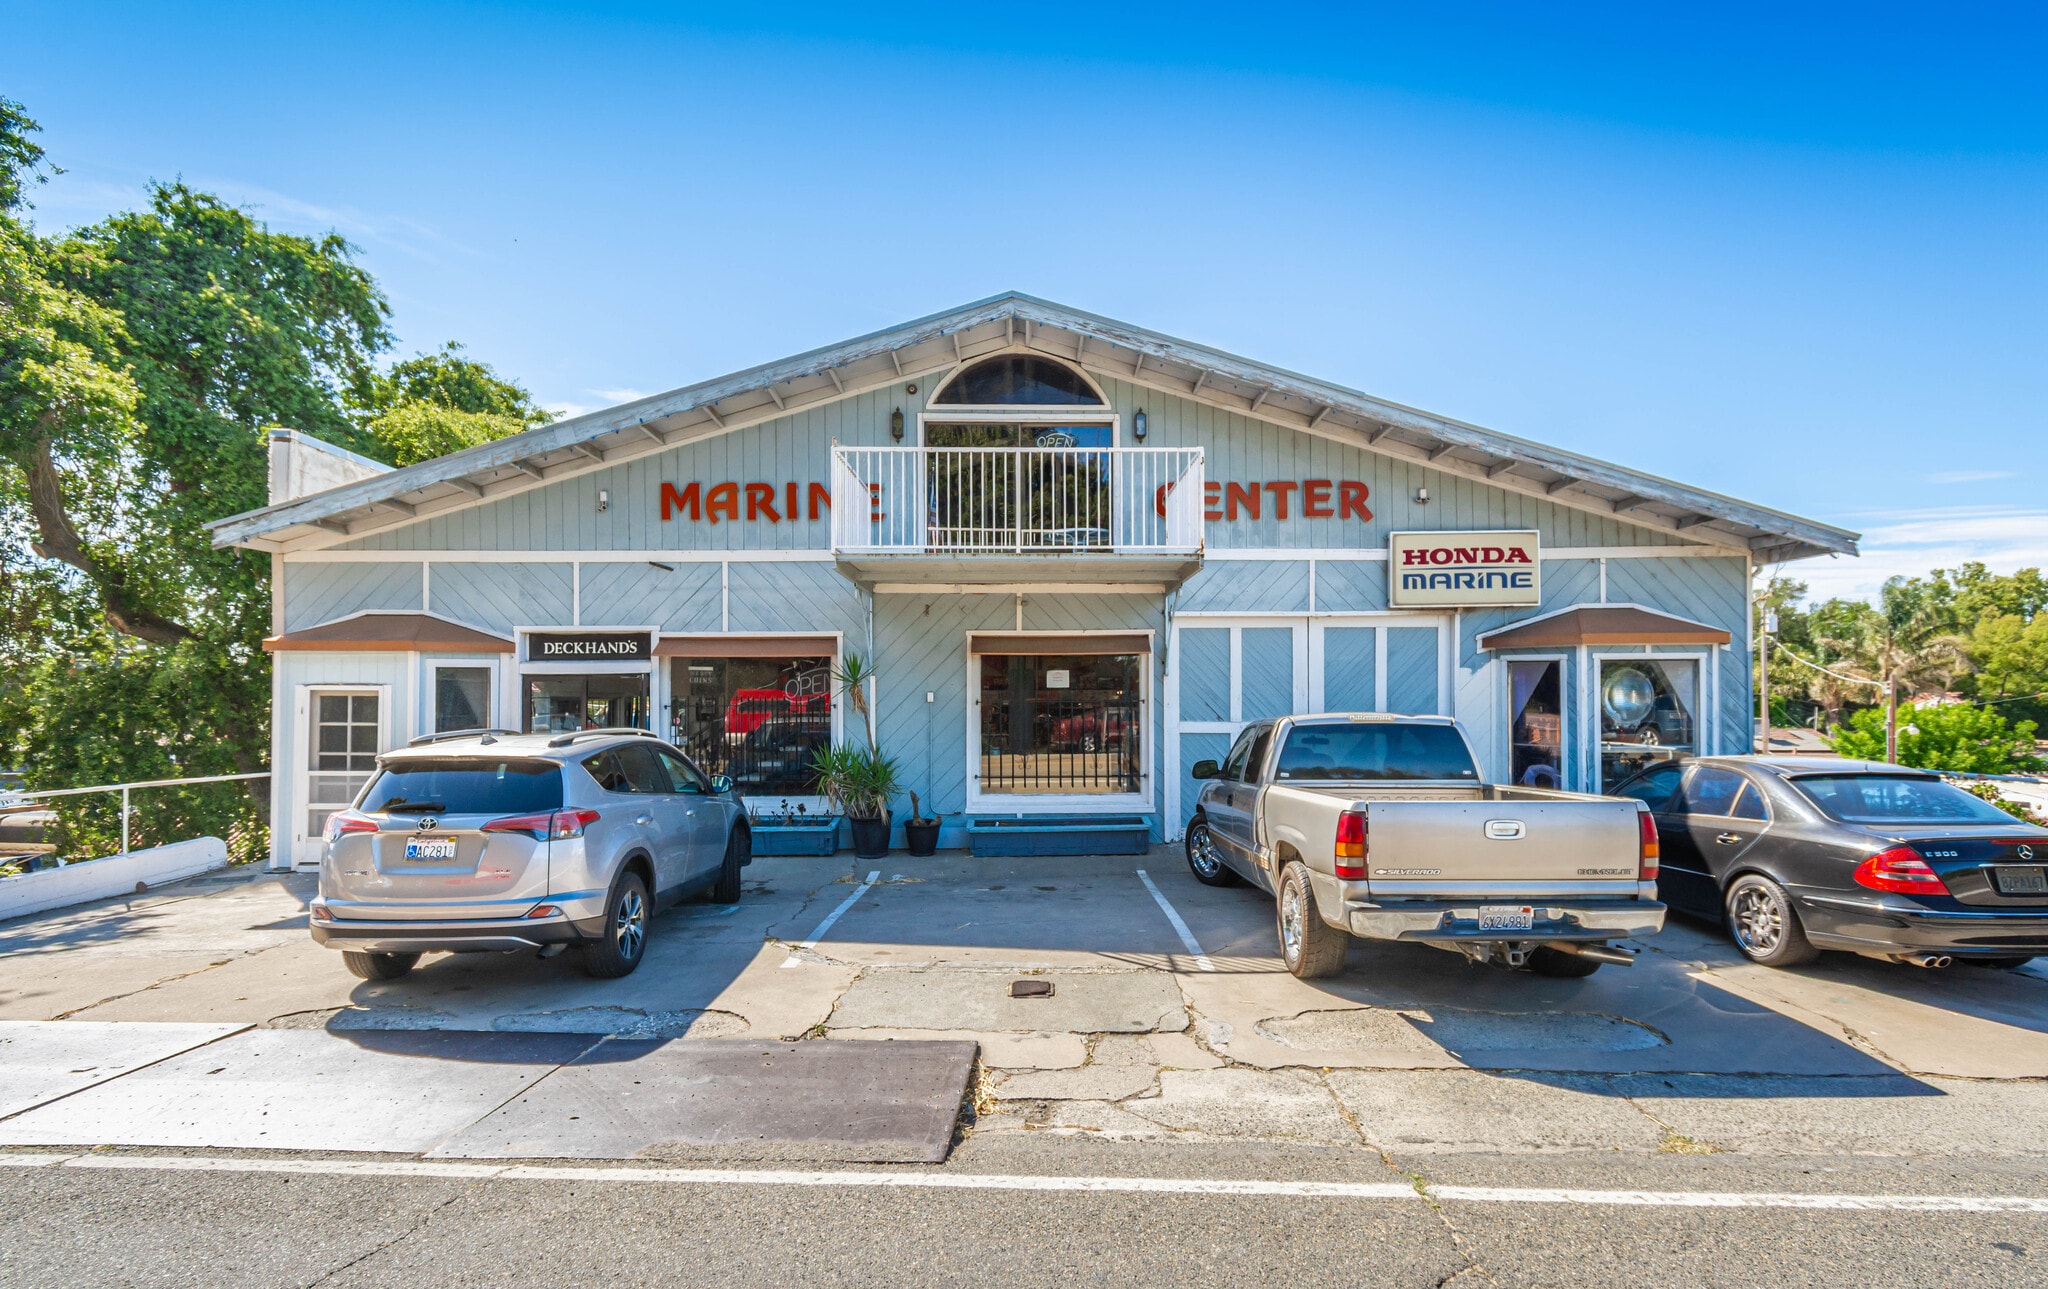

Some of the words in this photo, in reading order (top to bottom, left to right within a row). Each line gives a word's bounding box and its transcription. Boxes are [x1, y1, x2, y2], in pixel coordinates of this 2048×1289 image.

[1402, 547, 1532, 565] HONDA
[1402, 572, 1533, 590] MARINE
[543, 640, 638, 655] DECKHAND'S
